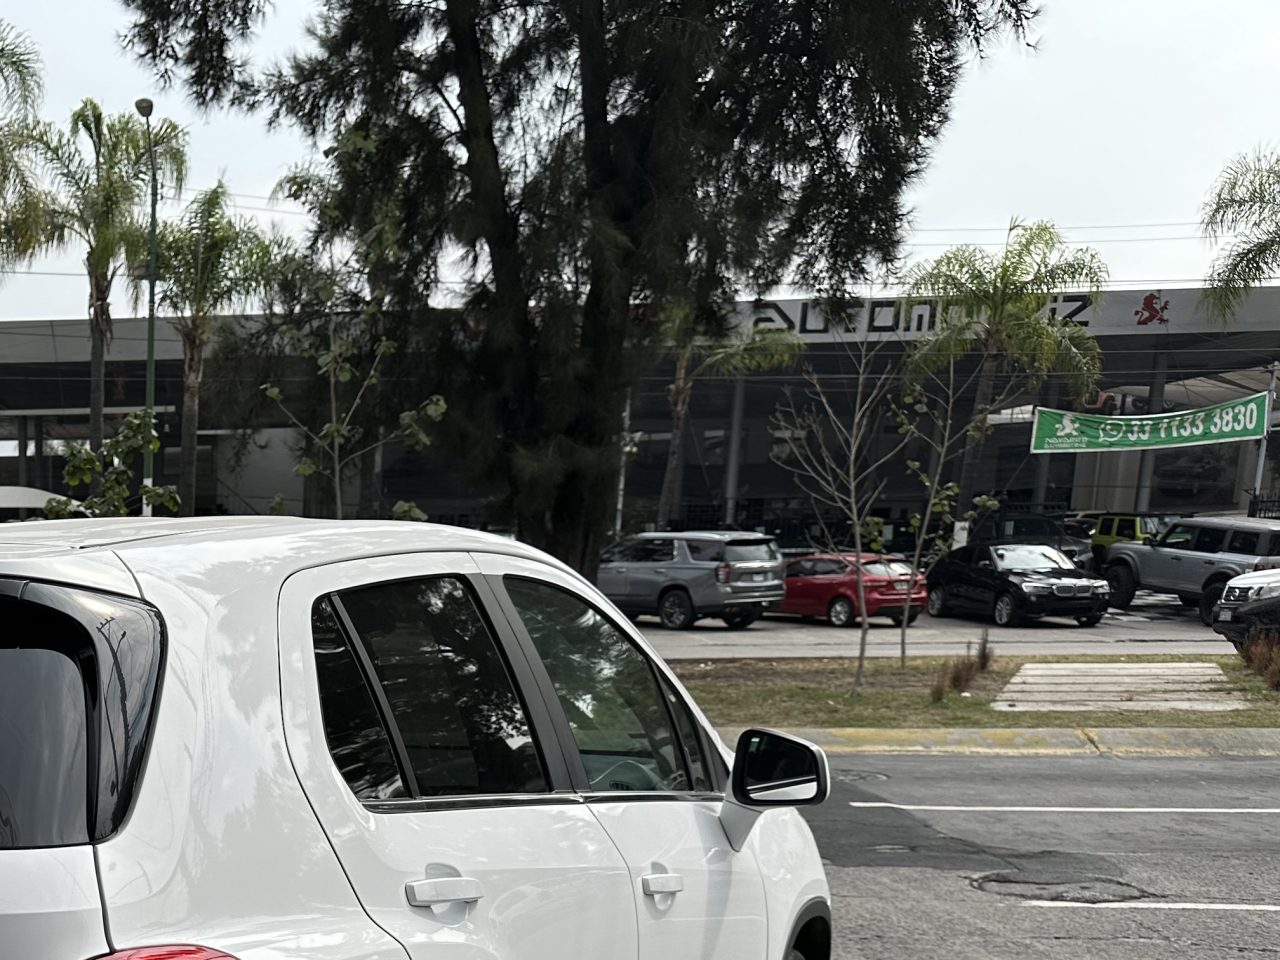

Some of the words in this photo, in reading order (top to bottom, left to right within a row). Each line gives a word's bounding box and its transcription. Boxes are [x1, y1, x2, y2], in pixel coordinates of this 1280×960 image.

[1127, 420, 1151, 441] 33
[1159, 412, 1205, 438] 1133
[1210, 402, 1258, 433] 3830
